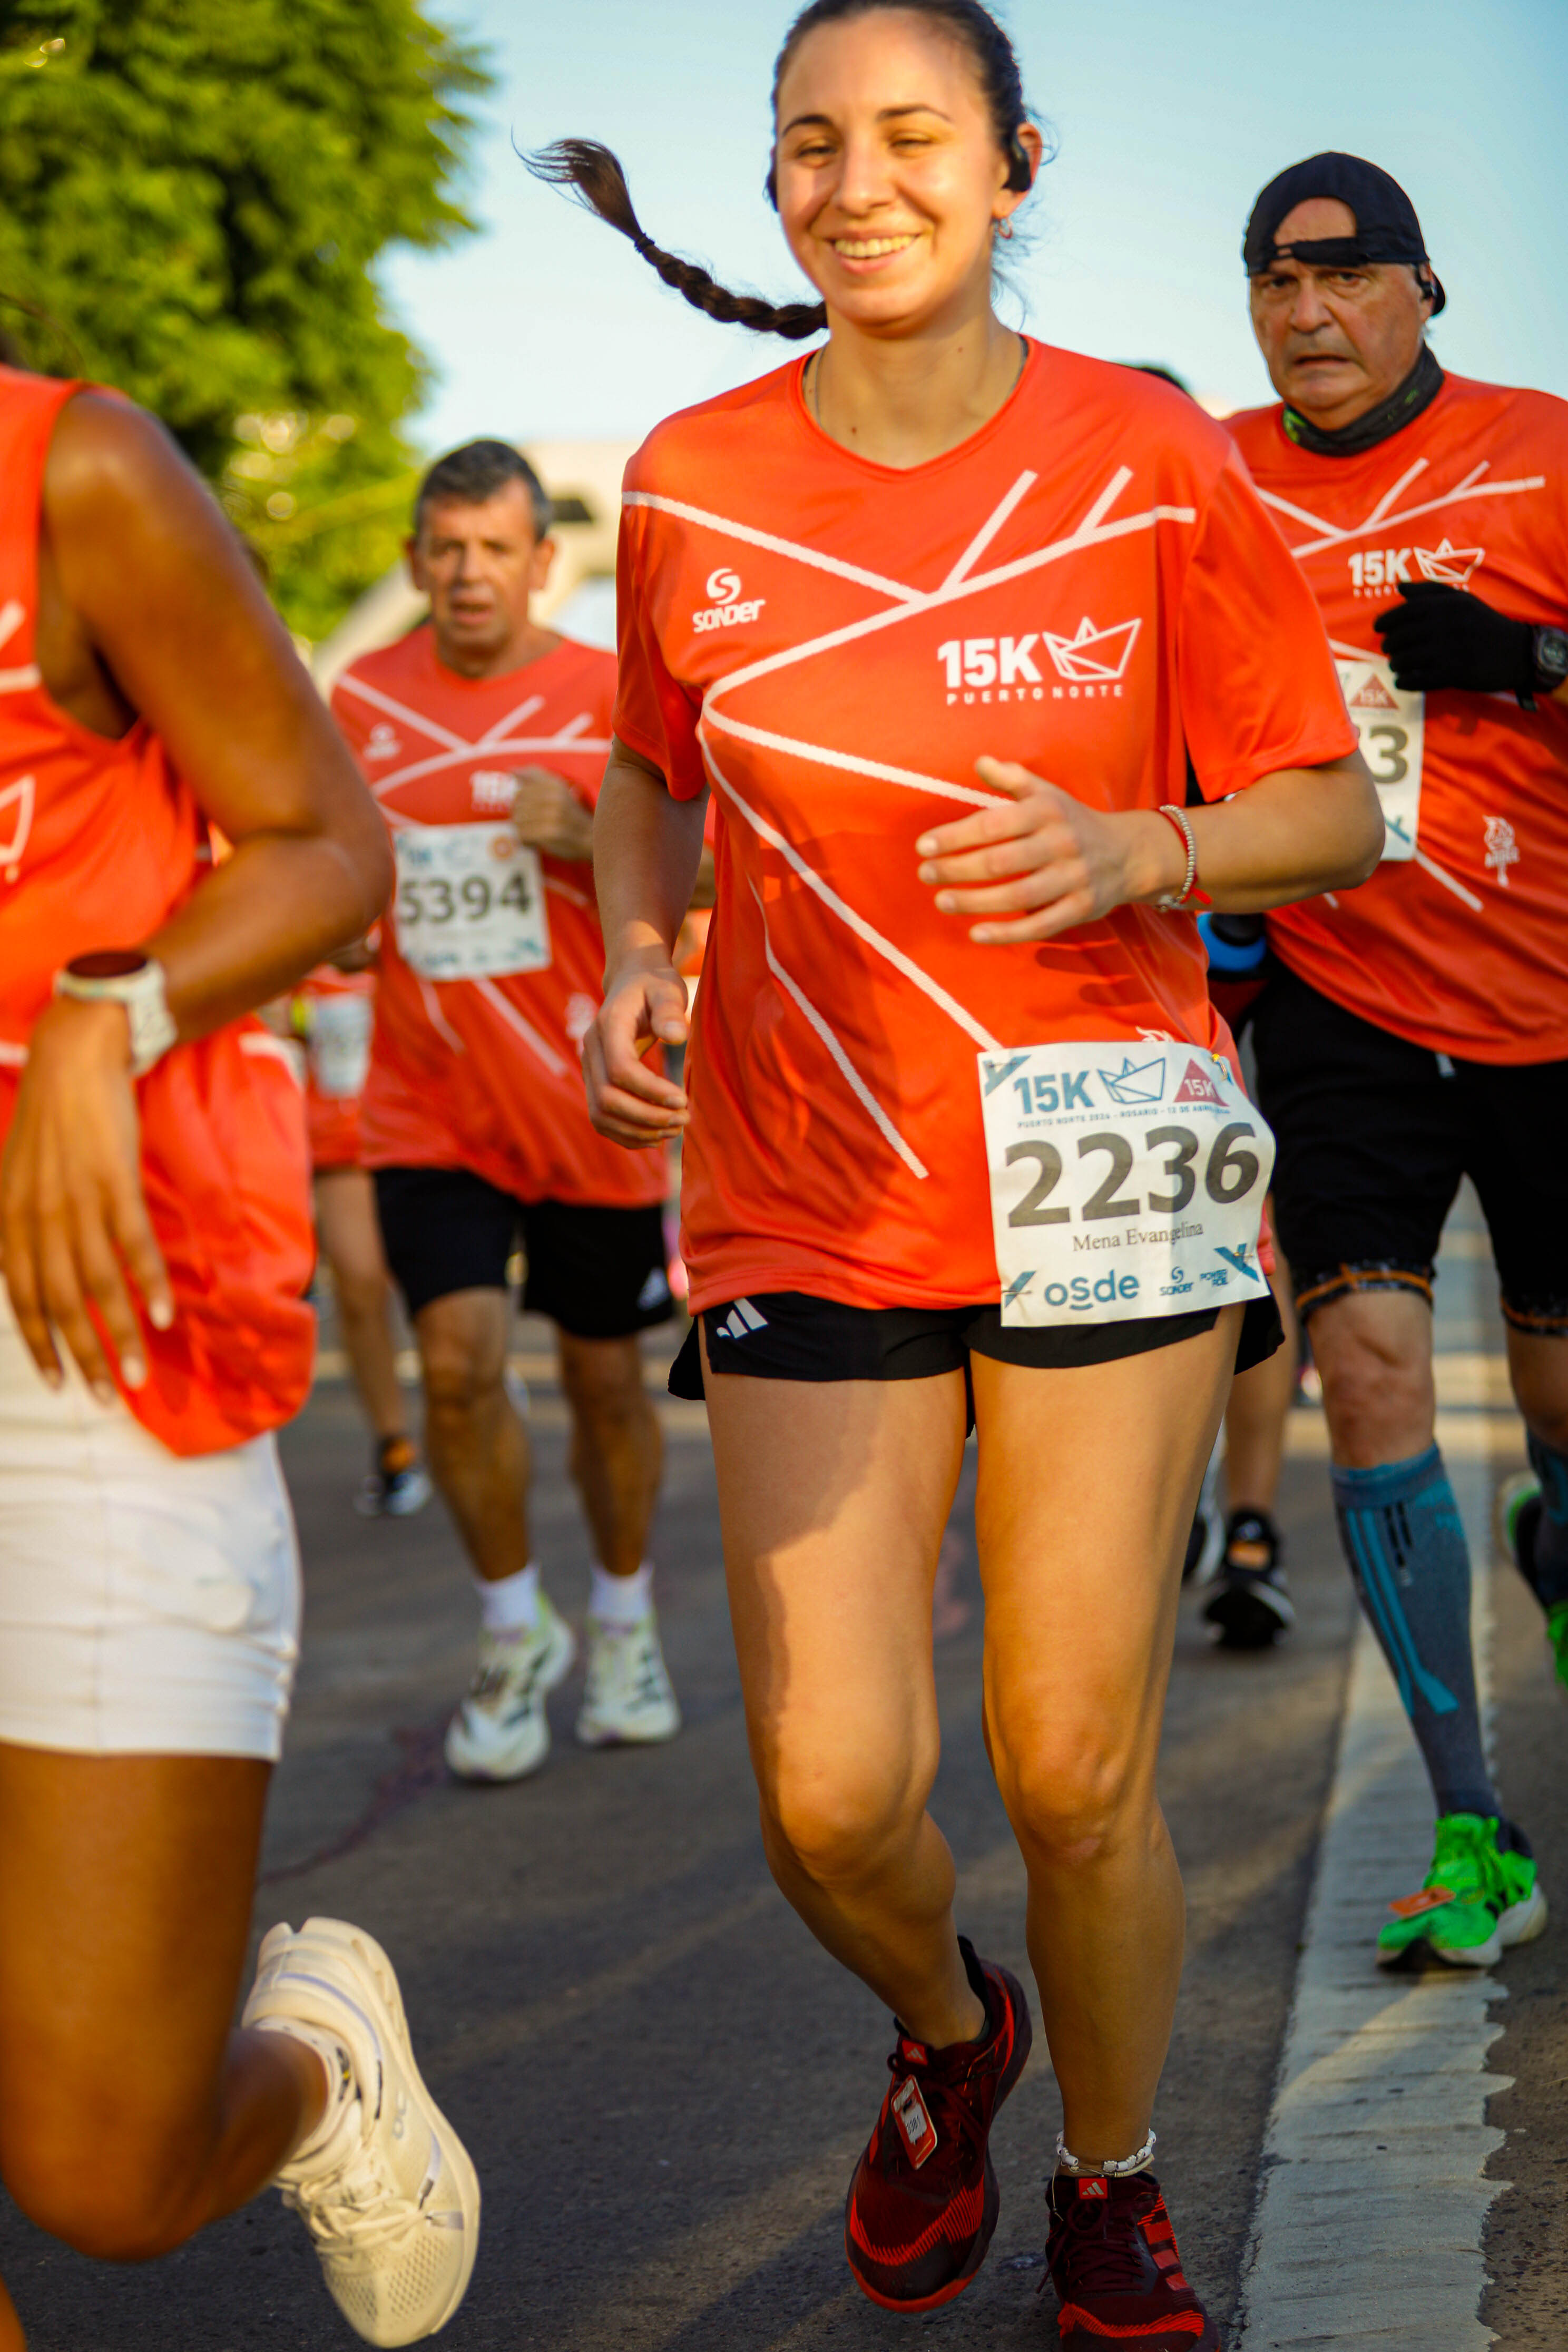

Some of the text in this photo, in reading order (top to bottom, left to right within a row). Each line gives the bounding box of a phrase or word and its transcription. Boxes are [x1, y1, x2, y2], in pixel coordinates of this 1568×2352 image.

[1348, 547, 1412, 587] 15K
[937, 633, 1043, 688] 15K
[947, 684, 1123, 706] PUERTO NORTE
[400, 870, 531, 926] 5394
[1014, 1070, 1217, 1114] 15K 15K
[1017, 1118, 1053, 1129] PUERTO
[1056, 1114, 1085, 1125] NORTE
[1120, 1108, 1158, 1118] ROSARIO
[1005, 1122, 1260, 1228] 2236
[1073, 1222, 1203, 1252] Mena Evangelina
[1044, 1269, 1140, 1311] osde
